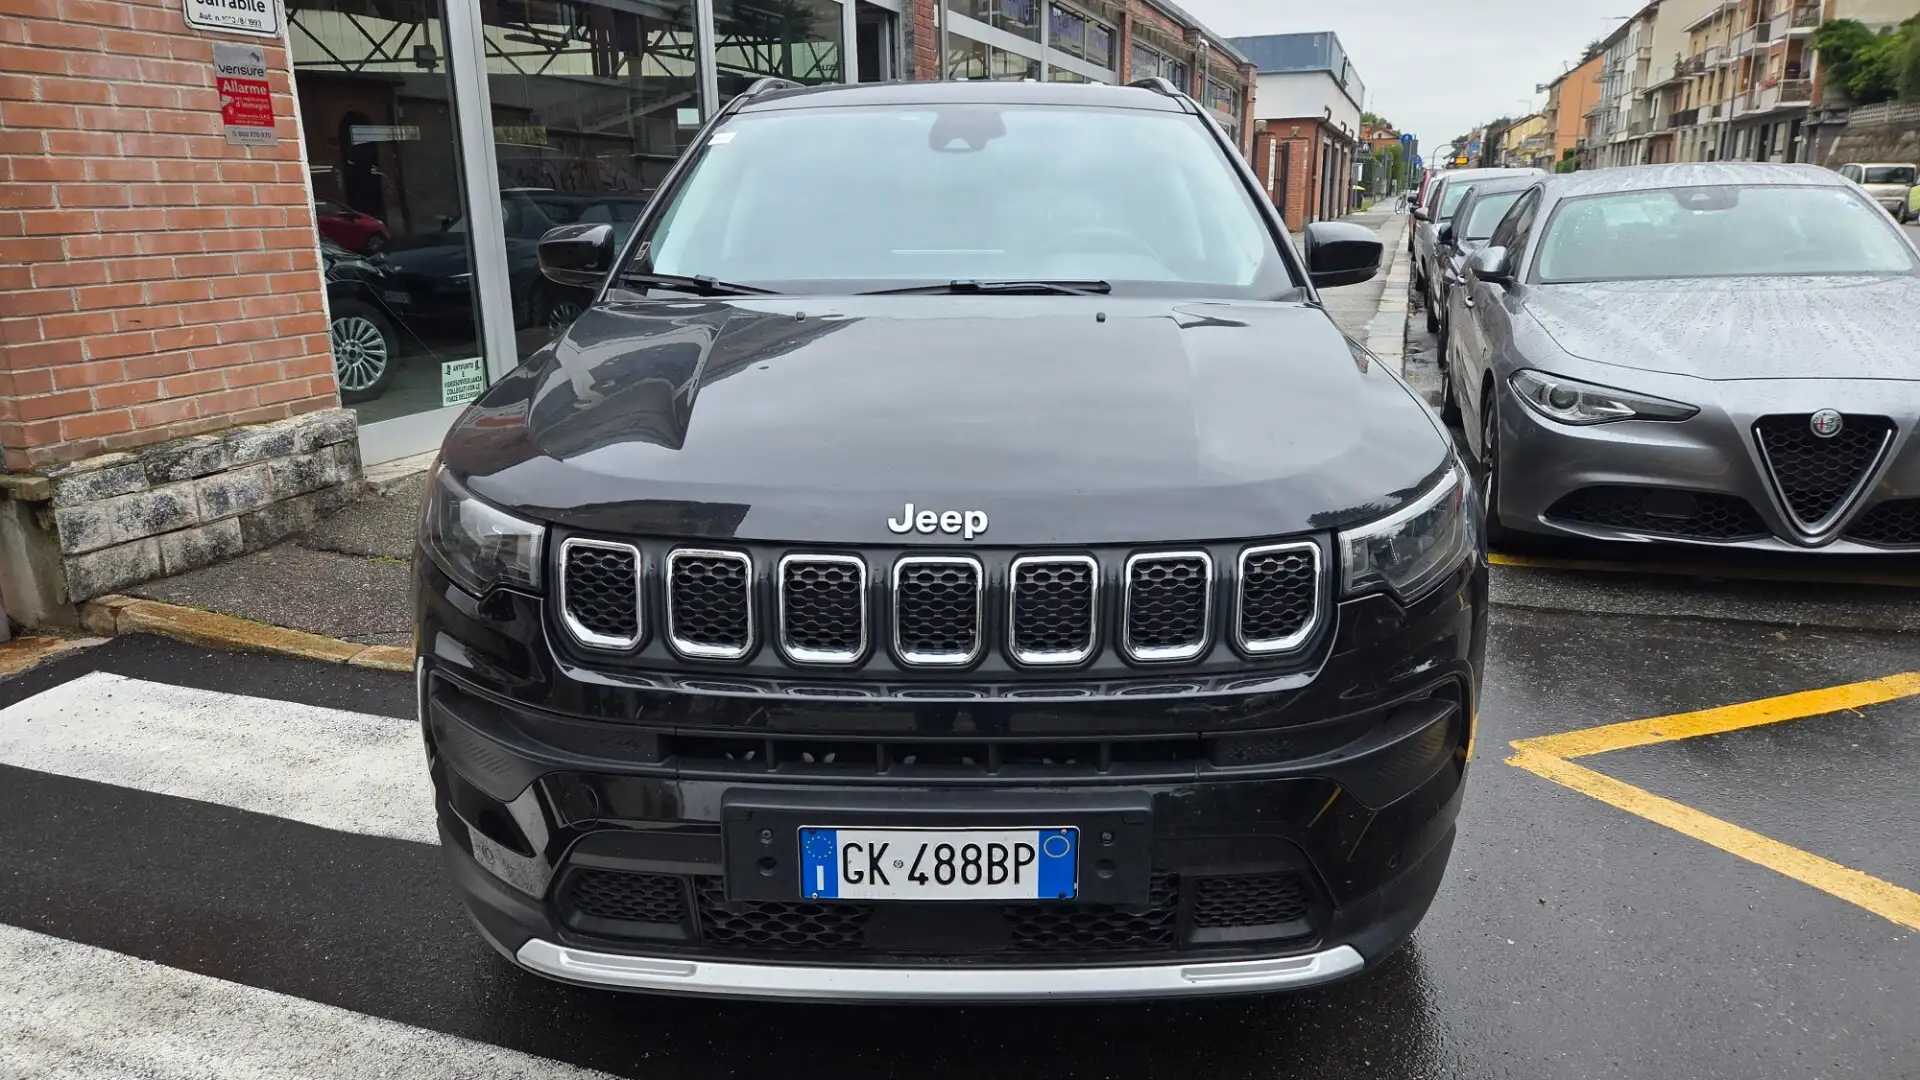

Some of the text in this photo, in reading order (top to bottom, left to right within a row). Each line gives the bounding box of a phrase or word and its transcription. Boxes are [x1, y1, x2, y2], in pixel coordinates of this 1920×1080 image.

[218, 64, 265, 77] verisure
[222, 79, 268, 95] Allarme
[887, 503, 989, 540] Jeep
[842, 842, 1036, 887] GK 488BP
